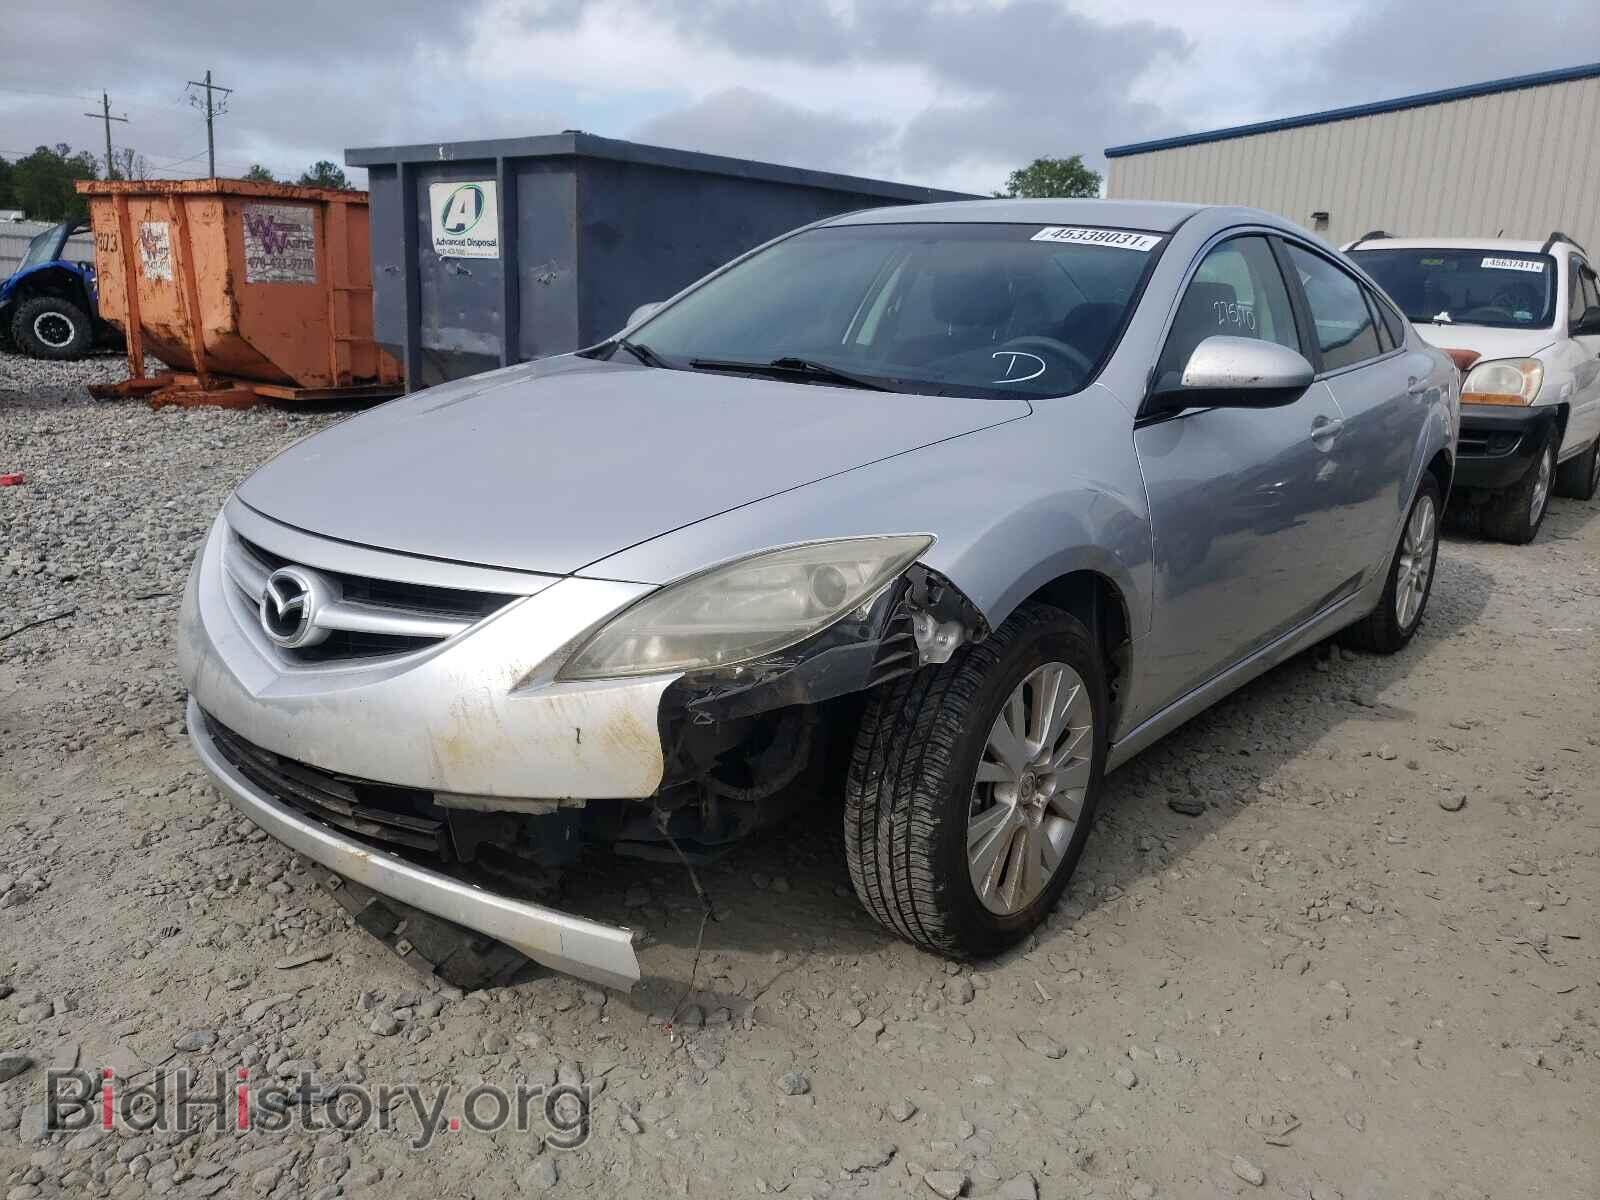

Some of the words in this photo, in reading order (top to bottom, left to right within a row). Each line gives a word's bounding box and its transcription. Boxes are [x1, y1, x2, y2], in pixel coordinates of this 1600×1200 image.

[436, 237, 465, 247] Advanced
[467, 237, 497, 249] Disposal
[1050, 228, 1143, 247] 45338031
[992, 351, 1046, 384] D
